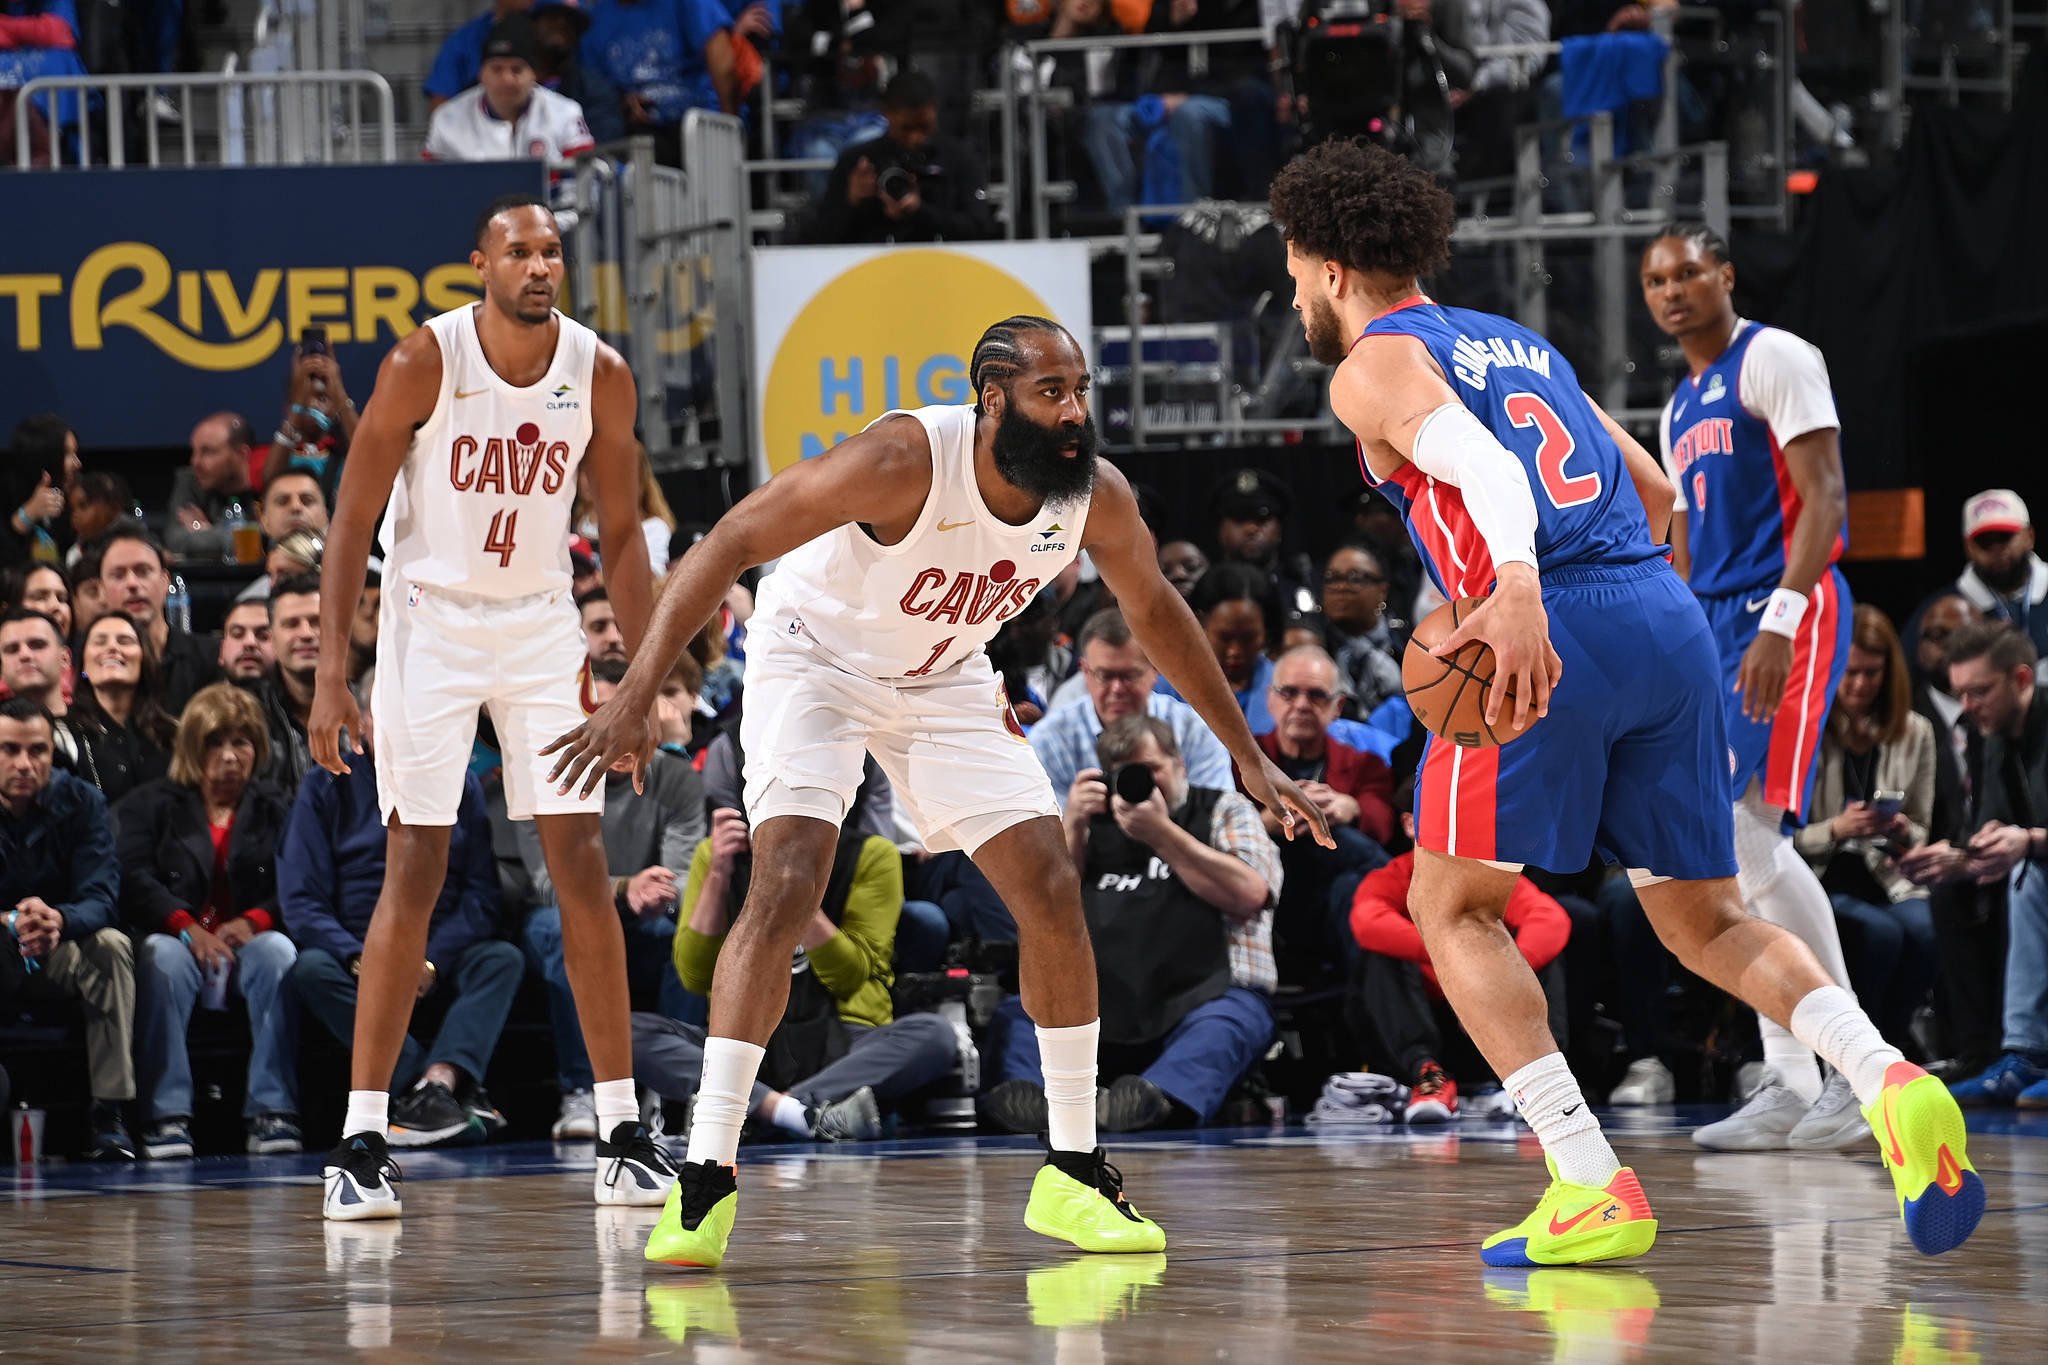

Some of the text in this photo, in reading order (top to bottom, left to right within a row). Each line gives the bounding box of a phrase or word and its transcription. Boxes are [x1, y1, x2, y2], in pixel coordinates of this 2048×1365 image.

[546, 401, 580, 411] CLIFFS
[820, 354, 972, 416] HIG
[450, 435, 570, 495] CAVS
[1503, 392, 1602, 510] 2
[483, 508, 519, 568] 4
[1030, 543, 1066, 552] CLIFFS
[899, 566, 1040, 625] CAVS
[903, 635, 957, 677] 1
